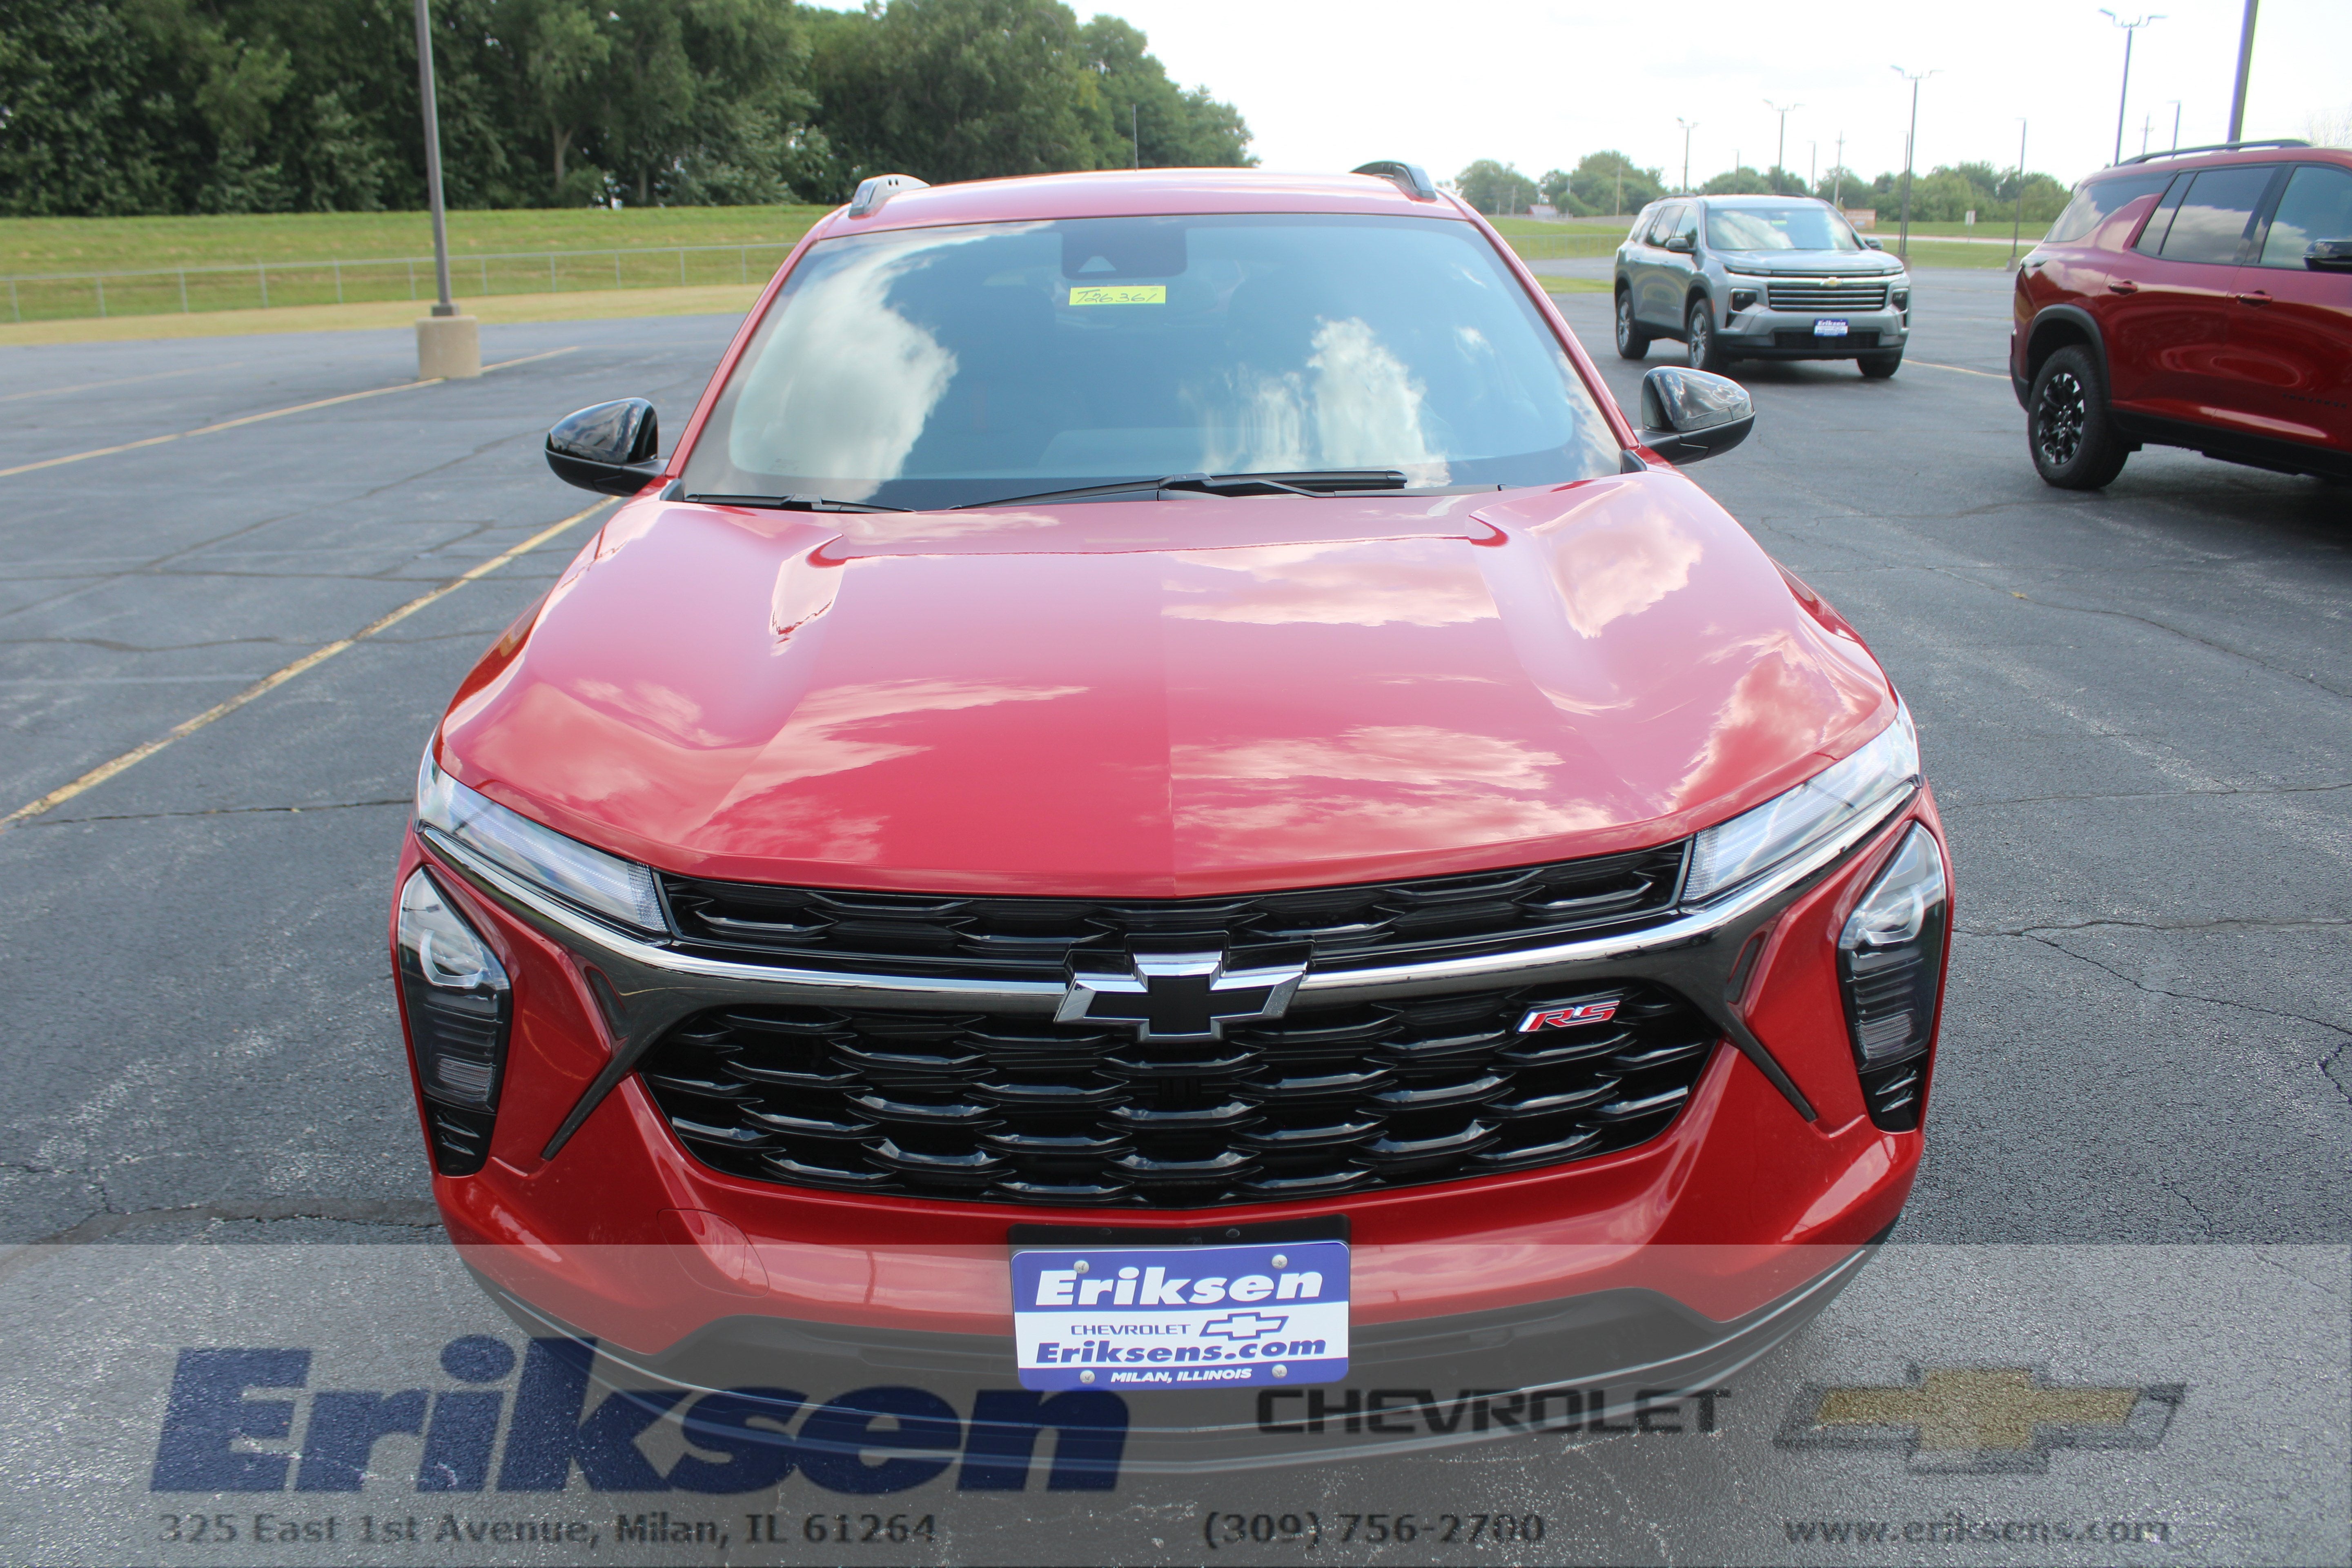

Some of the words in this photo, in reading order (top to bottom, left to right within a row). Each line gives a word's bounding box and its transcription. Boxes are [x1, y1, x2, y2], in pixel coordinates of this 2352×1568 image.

[1518, 1000, 1620, 1032] RS
[1036, 1267, 1323, 1305] Eriksen
[1071, 1323, 1191, 1336] CHEVROLET
[1035, 1338, 1326, 1364] Eriksens.com
[1110, 1371, 1172, 1384] MILAN,
[1176, 1368, 1252, 1382] ILLINOIS
